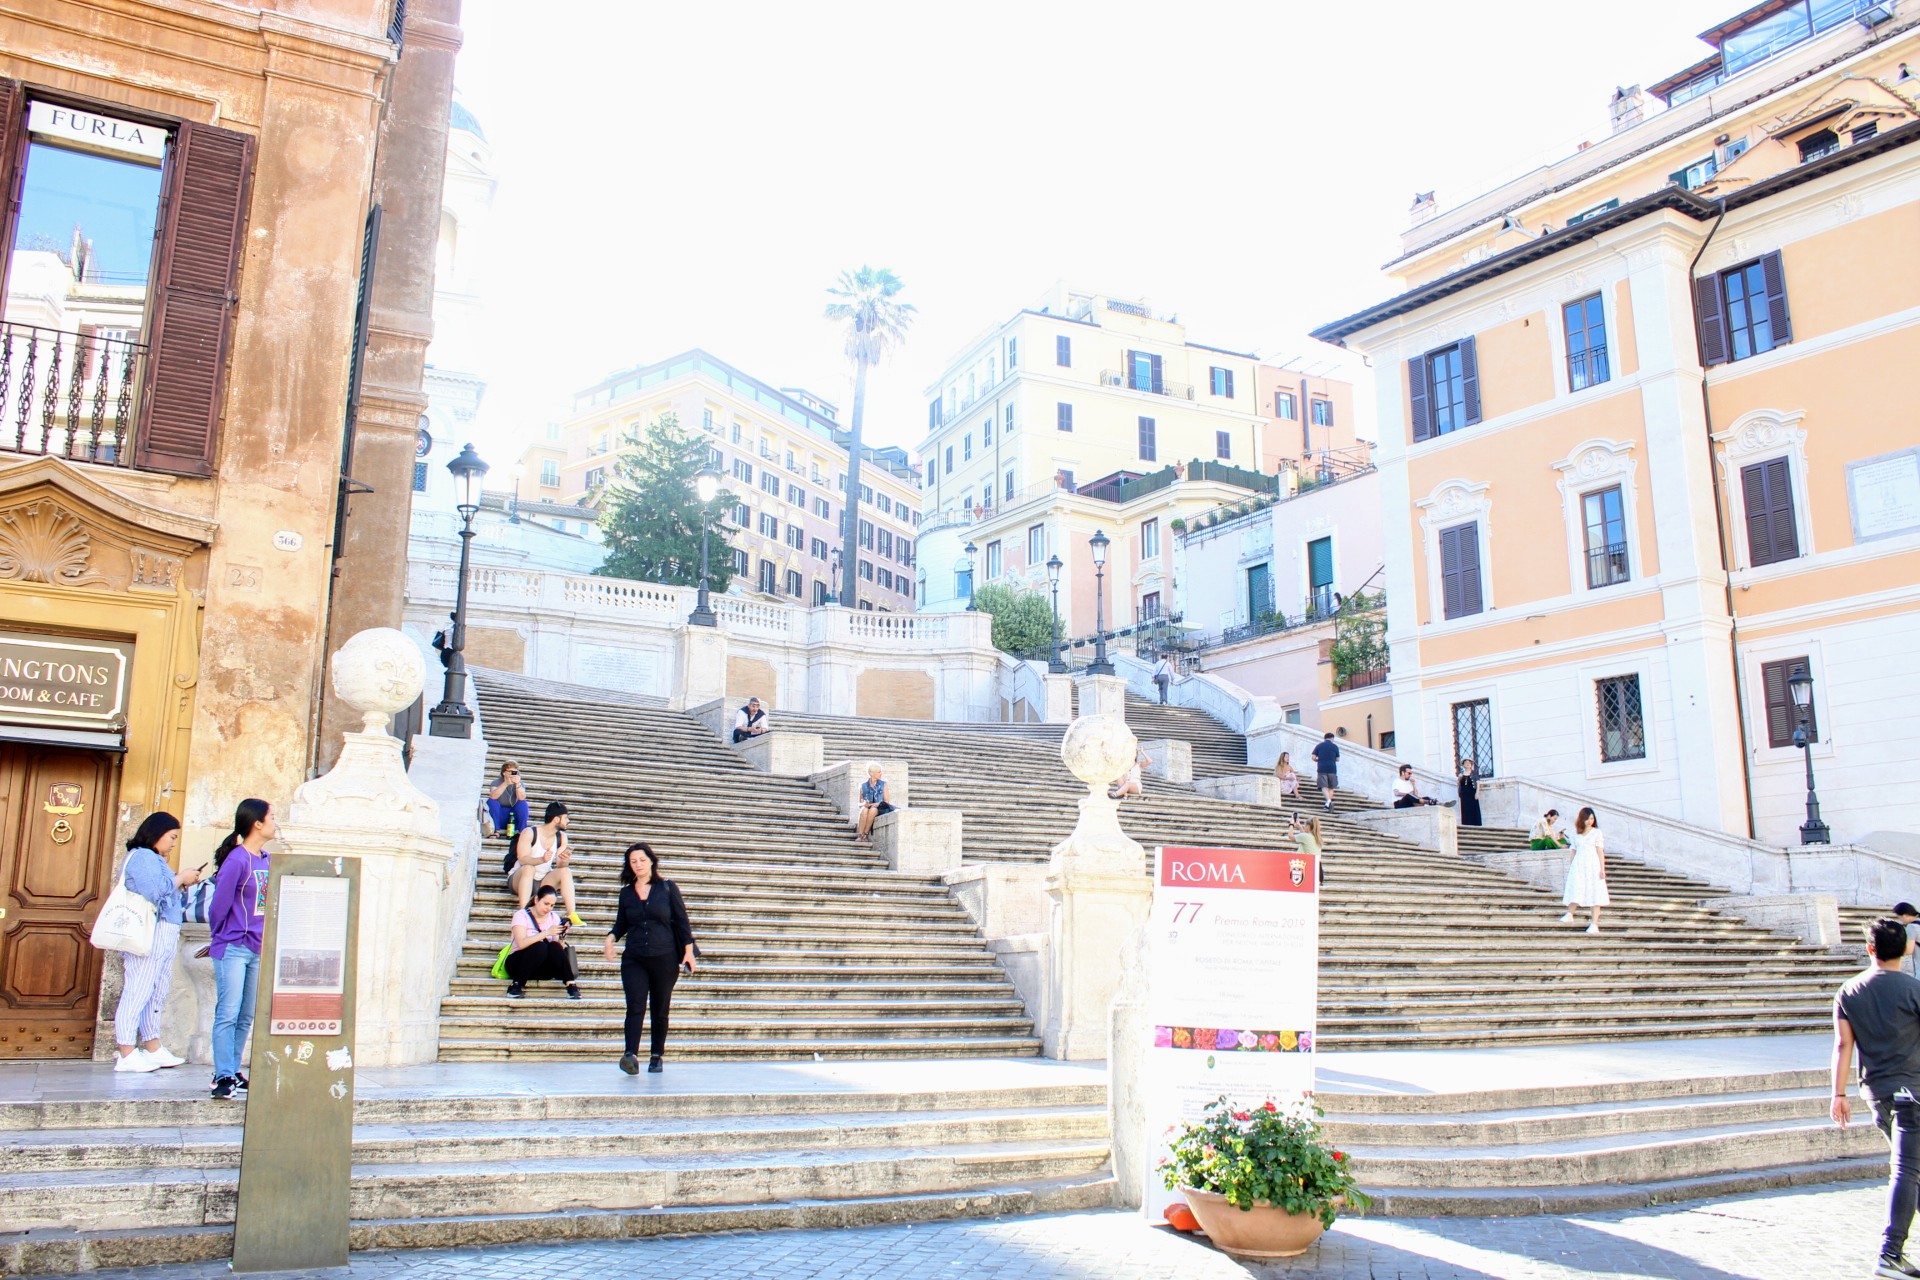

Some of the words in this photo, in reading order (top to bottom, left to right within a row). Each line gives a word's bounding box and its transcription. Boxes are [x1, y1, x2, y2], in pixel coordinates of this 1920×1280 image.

[51, 109, 145, 145] FURLA
[0, 658, 109, 685] NGTONS
[37, 690, 51, 703] &
[53, 787, 74, 808] ROMA
[1171, 861, 1247, 884] ROMA
[1173, 902, 1204, 924] 77
[1214, 914, 1248, 927] Premio
[1252, 916, 1279, 928] Roma
[1281, 917, 1306, 929] 2019
